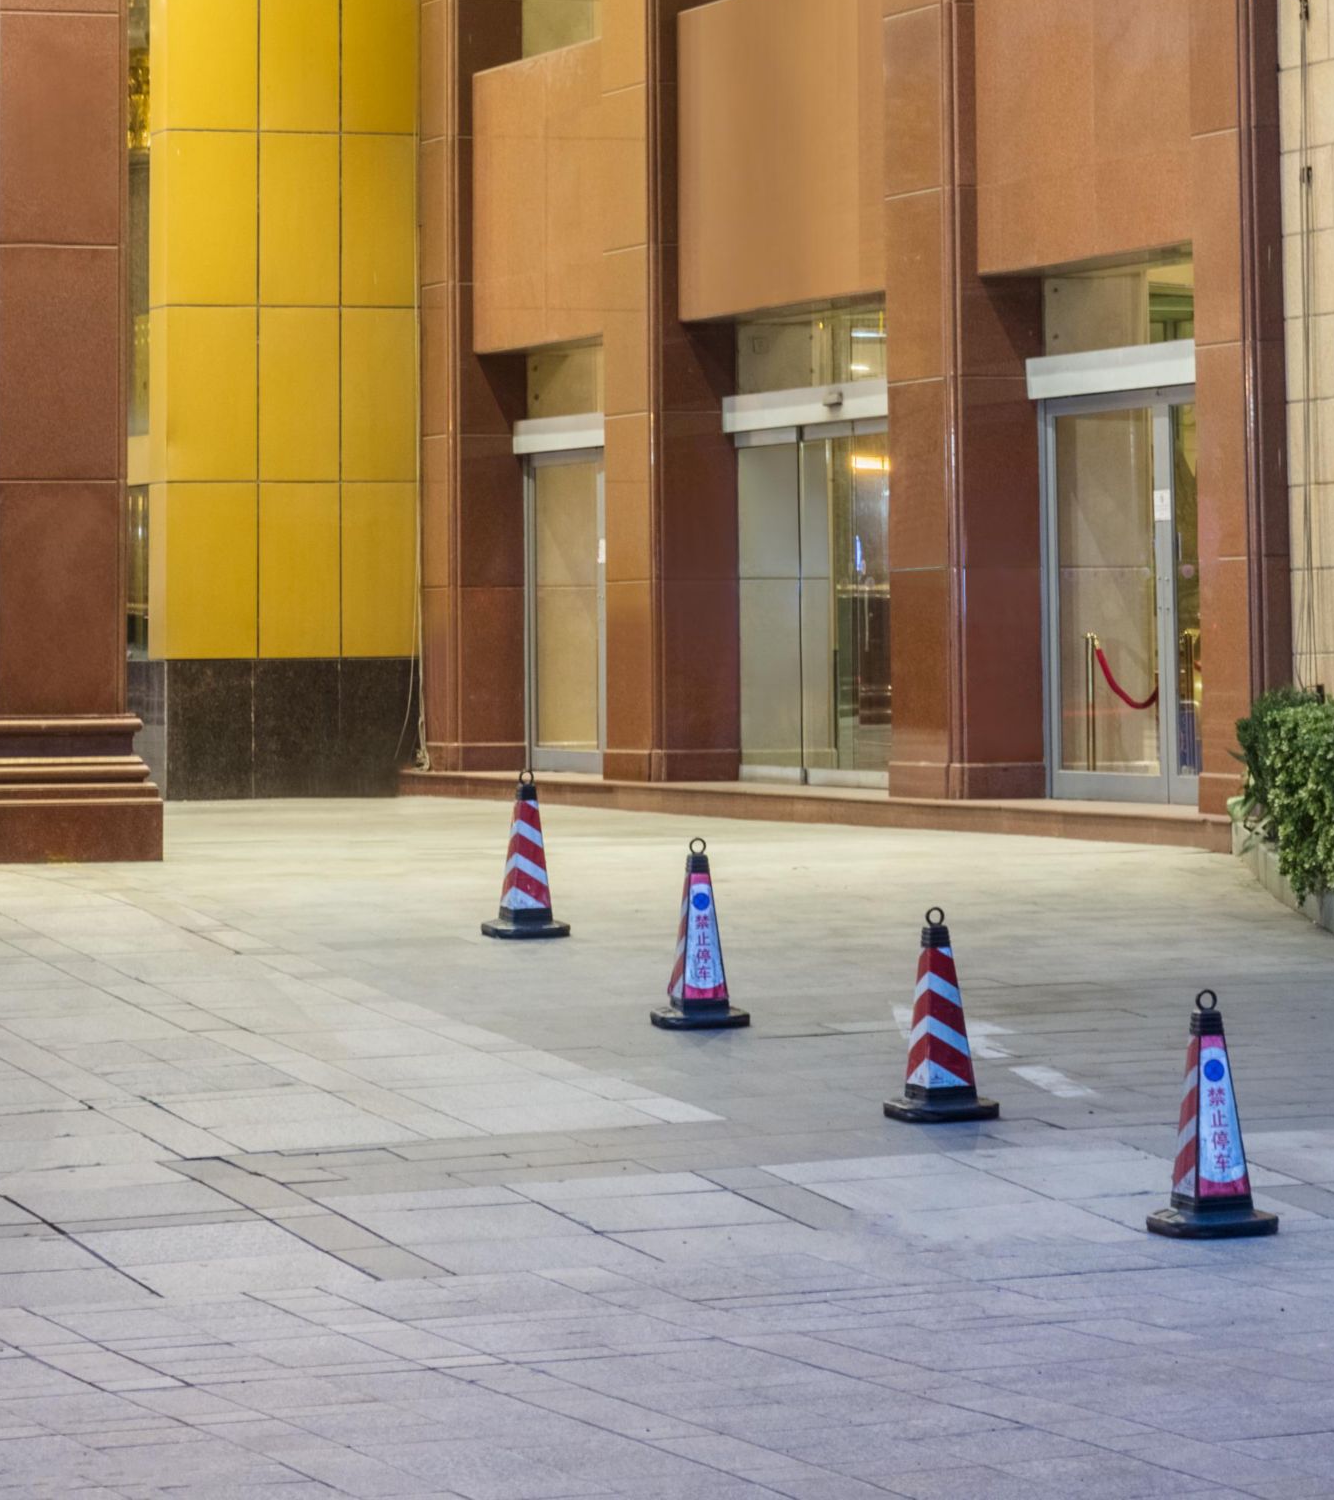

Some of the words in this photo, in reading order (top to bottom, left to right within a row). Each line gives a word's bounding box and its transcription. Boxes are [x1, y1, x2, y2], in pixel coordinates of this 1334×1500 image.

[694, 914, 712, 981] 禁止停车
[1207, 1087, 1232, 1174] 禁止停车
